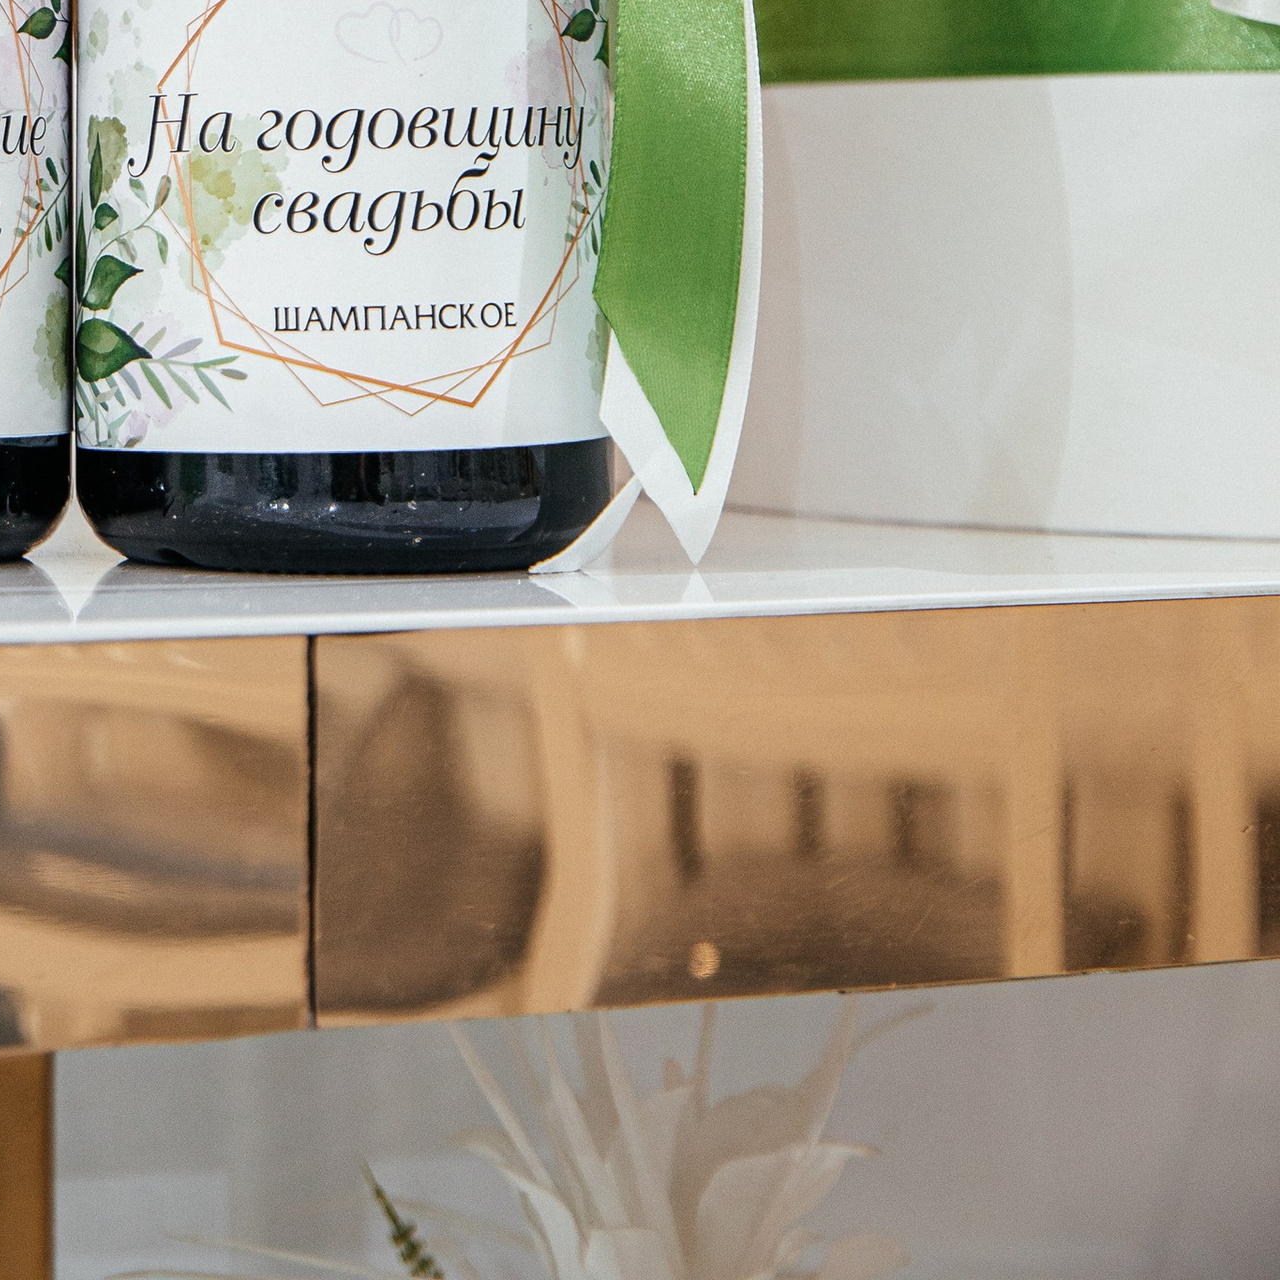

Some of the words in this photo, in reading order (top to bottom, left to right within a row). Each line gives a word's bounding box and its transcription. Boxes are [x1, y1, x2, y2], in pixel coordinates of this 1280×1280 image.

[126, 92, 237, 179] На
[255, 104, 586, 174] годовщину
[251, 150, 527, 257] свадьбы
[273, 302, 518, 333] ШАМПАНСКОЕ
